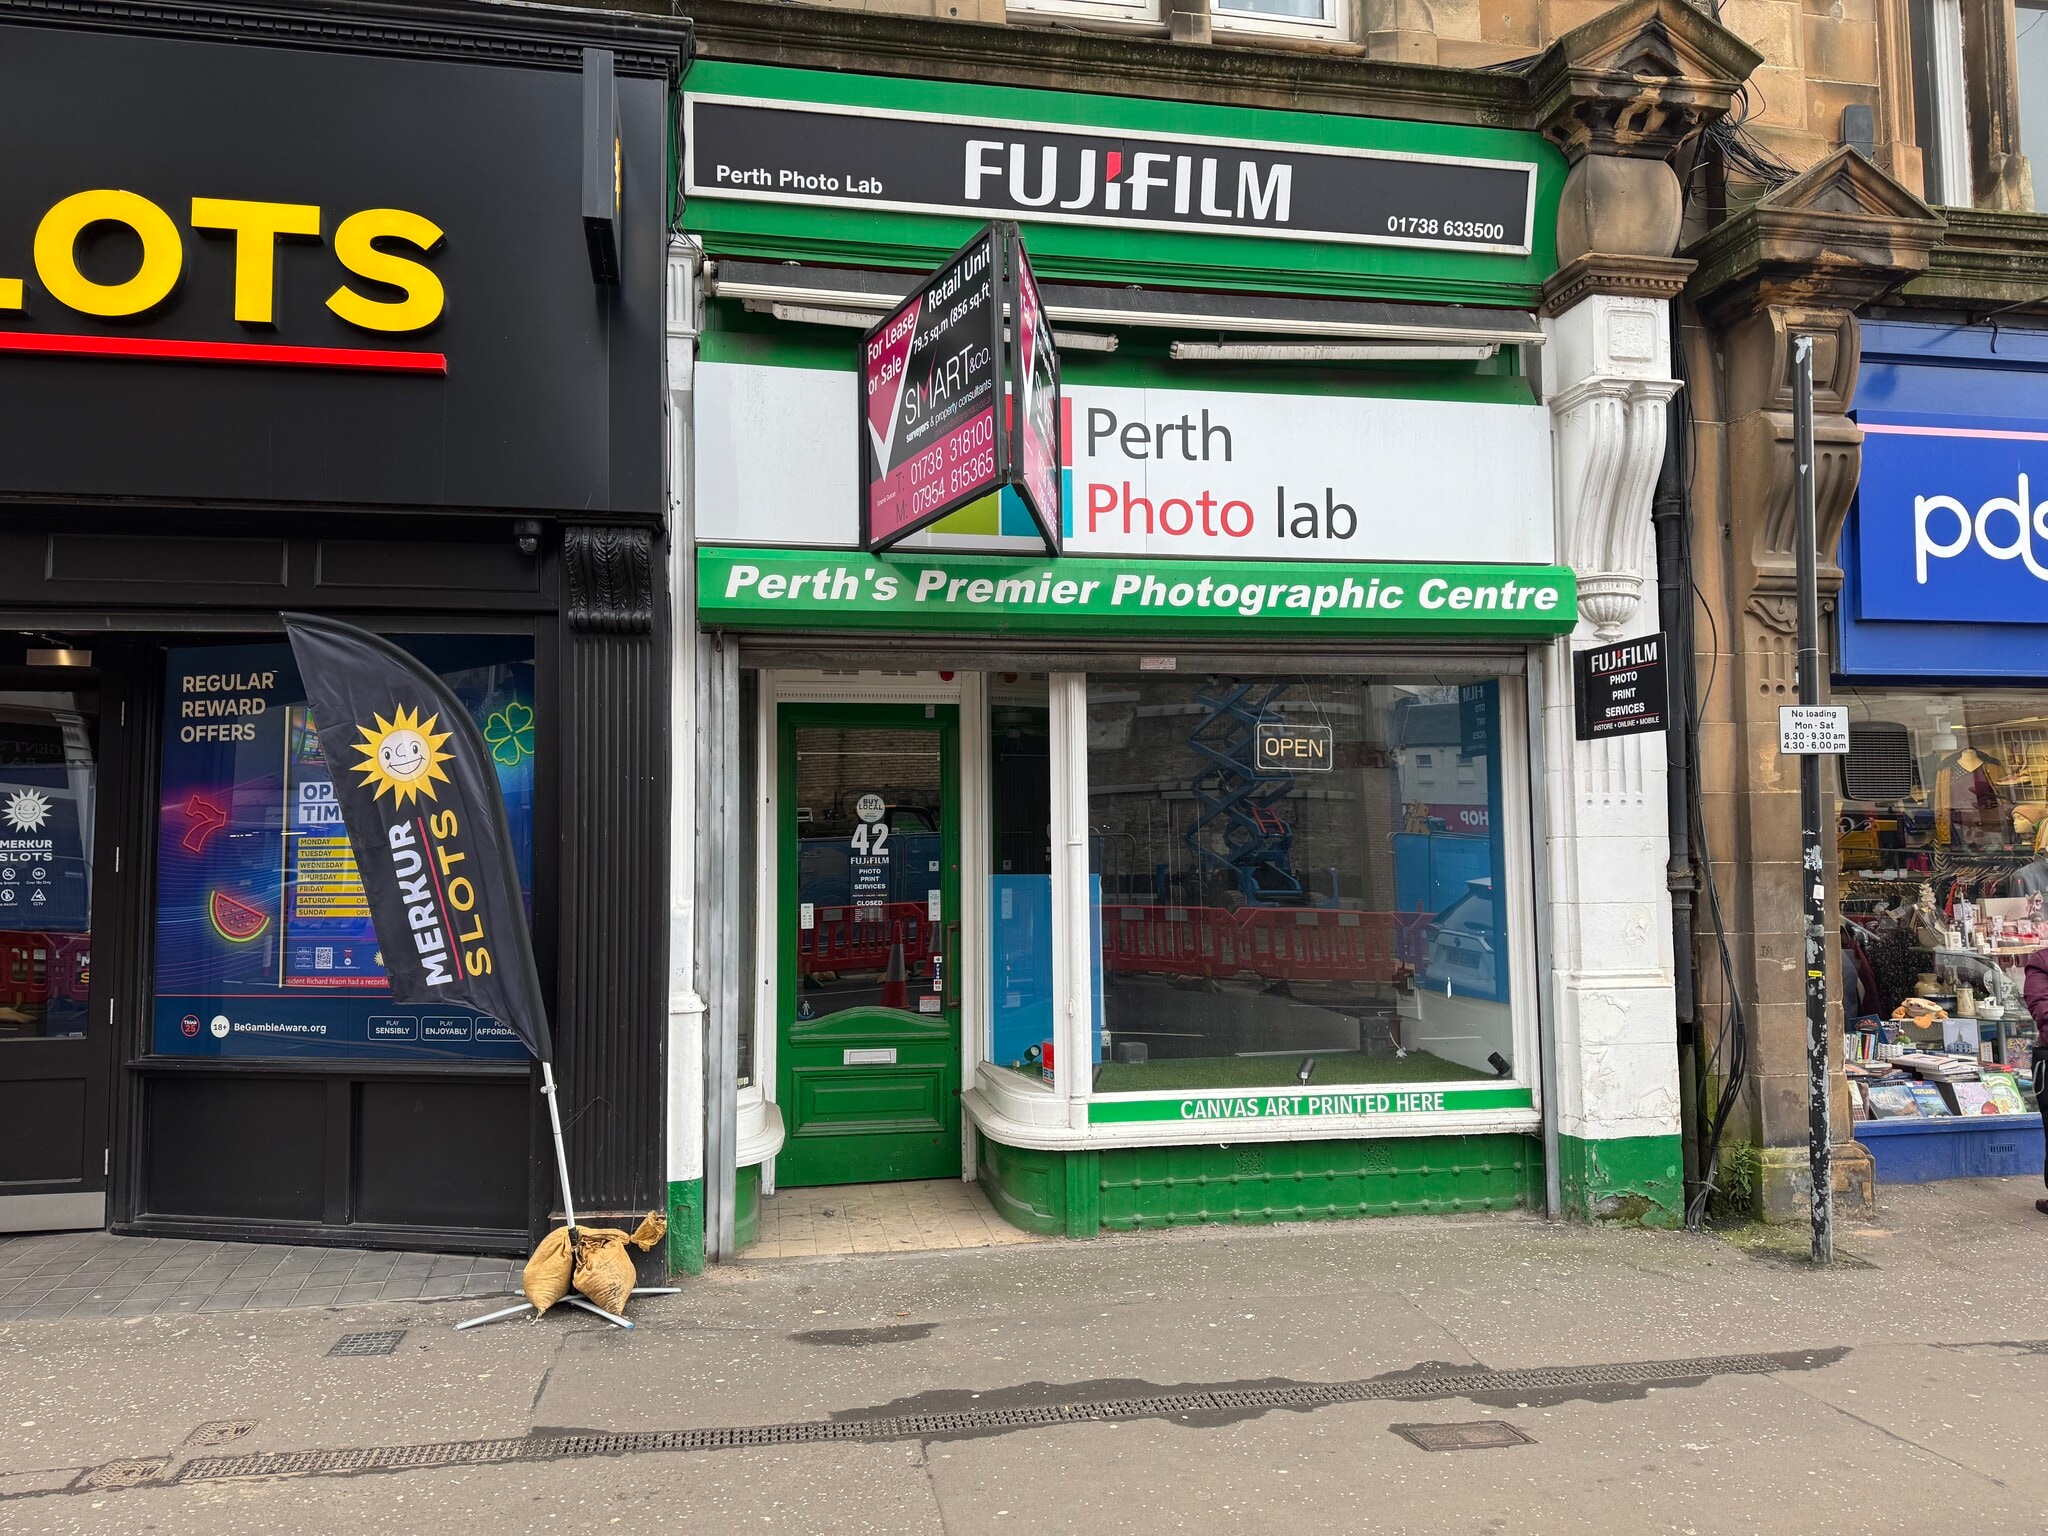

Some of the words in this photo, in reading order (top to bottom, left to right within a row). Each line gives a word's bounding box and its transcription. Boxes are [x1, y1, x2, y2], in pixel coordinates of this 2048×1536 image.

[716, 164, 772, 186] Perth
[779, 169, 839, 192] Photo
[846, 175, 883, 194] Lab
[964, 139, 1292, 221] FUJIFILM
[1387, 215, 1439, 235] 01738
[1443, 220, 1504, 240] 633500
[0, 189, 445, 332] OTS
[928, 268, 960, 313] Retail
[964, 242, 990, 281] Unit
[867, 337, 884, 365] For
[885, 312, 915, 350] Lease
[913, 337, 929, 355] 79.5
[930, 317, 948, 341] sq.m
[950, 301, 968, 327] (856
[868, 374, 880, 396] or
[881, 354, 902, 386] Sale
[906, 420, 930, 443] surveyors
[935, 401, 957, 426] property
[958, 379, 991, 408] consultants
[1088, 407, 1232, 462] Perth
[910, 447, 943, 485] 01738
[950, 415, 993, 462] 318100
[912, 477, 945, 514] 07954
[951, 448, 994, 493] 815365
[1088, 481, 1255, 537] Photo
[1277, 485, 1358, 540] lab
[724, 565, 899, 602] Perth's
[914, 570, 1101, 605] Premier
[1110, 574, 1404, 616] Photographic
[1418, 576, 1559, 611] Centre
[1591, 642, 1658, 673] FUJIFILM
[183, 672, 274, 693] REGULAR
[1609, 671, 1638, 685] PHOTO
[1612, 688, 1637, 701] PRINT
[182, 698, 266, 718] REWARD
[1605, 702, 1645, 718] SERVICES
[1806, 710, 1837, 718] loading
[180, 723, 256, 743] OFFERS
[1593, 722, 1614, 732] INSTORE
[1617, 719, 1636, 728] ONLINE
[1640, 716, 1660, 725] MOBILE
[1795, 721, 1813, 729] Mon
[1819, 721, 1834, 729] Sat
[1265, 738, 1323, 757] OPEN
[1783, 742, 1805, 750] 4.30
[1811, 742, 1832, 750] 6.00
[1784, 732, 1805, 740] 8.30
[1811, 732, 1831, 740] 9.30
[0, 840, 53, 849] MERKUR
[851, 823, 889, 856] 42
[0, 852, 53, 862] SLOTS
[850, 856, 889, 865] FUJIFILM
[388, 819, 453, 987] MERKUR
[430, 809, 492, 977] SLOTS
[307, 977, 327, 985] Richard
[330, 977, 346, 985] Nixon
[347, 977, 358, 985] had
[185, 1025, 196, 1033] 25
[213, 1023, 227, 1031] 18+
[234, 1023, 327, 1035] BeGambleAware.org
[1180, 1097, 1259, 1120] CANVAS
[1265, 1096, 1303, 1116] ART
[1308, 1094, 1390, 1115] PRINTED
[1396, 1093, 1445, 1112] HERE
